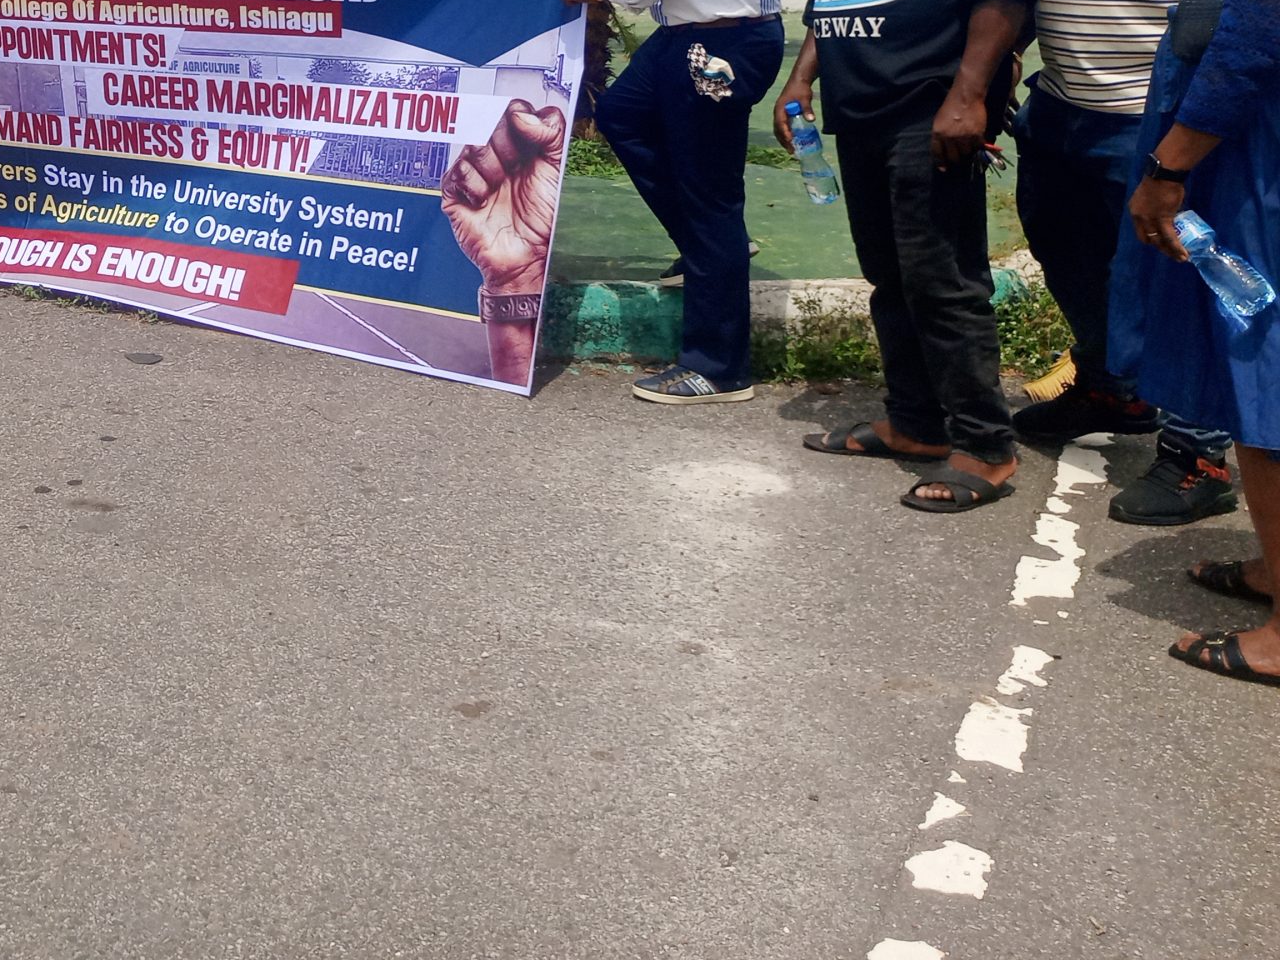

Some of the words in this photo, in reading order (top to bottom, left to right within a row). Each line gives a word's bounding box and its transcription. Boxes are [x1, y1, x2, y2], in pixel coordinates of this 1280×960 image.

[72, 0, 97, 21] Of
[99, 0, 237, 31] Agriculture,
[239, 5, 333, 33] Ishiagu
[813, 16, 886, 39] CEWAY
[182, 61, 240, 74] AGRICULTURE
[103, 72, 199, 111] CAREER
[206, 78, 459, 134] MARGINALIZATION!
[69, 117, 184, 159] FAIRNESS
[191, 125, 208, 160] &
[218, 128, 312, 174] EQUITY!
[44, 164, 94, 195] Stay
[102, 170, 123, 194] in
[130, 174, 166, 200] the
[173, 179, 293, 222] University
[298, 195, 403, 234] System!
[14, 192, 38, 213] of
[42, 196, 159, 230] Agriculture
[164, 211, 190, 234] to
[195, 217, 293, 252] Operate
[298, 232, 322, 257] in
[330, 235, 420, 273] Peace!
[61, 242, 94, 272] IS
[97, 244, 247, 302] ENOUGH!
